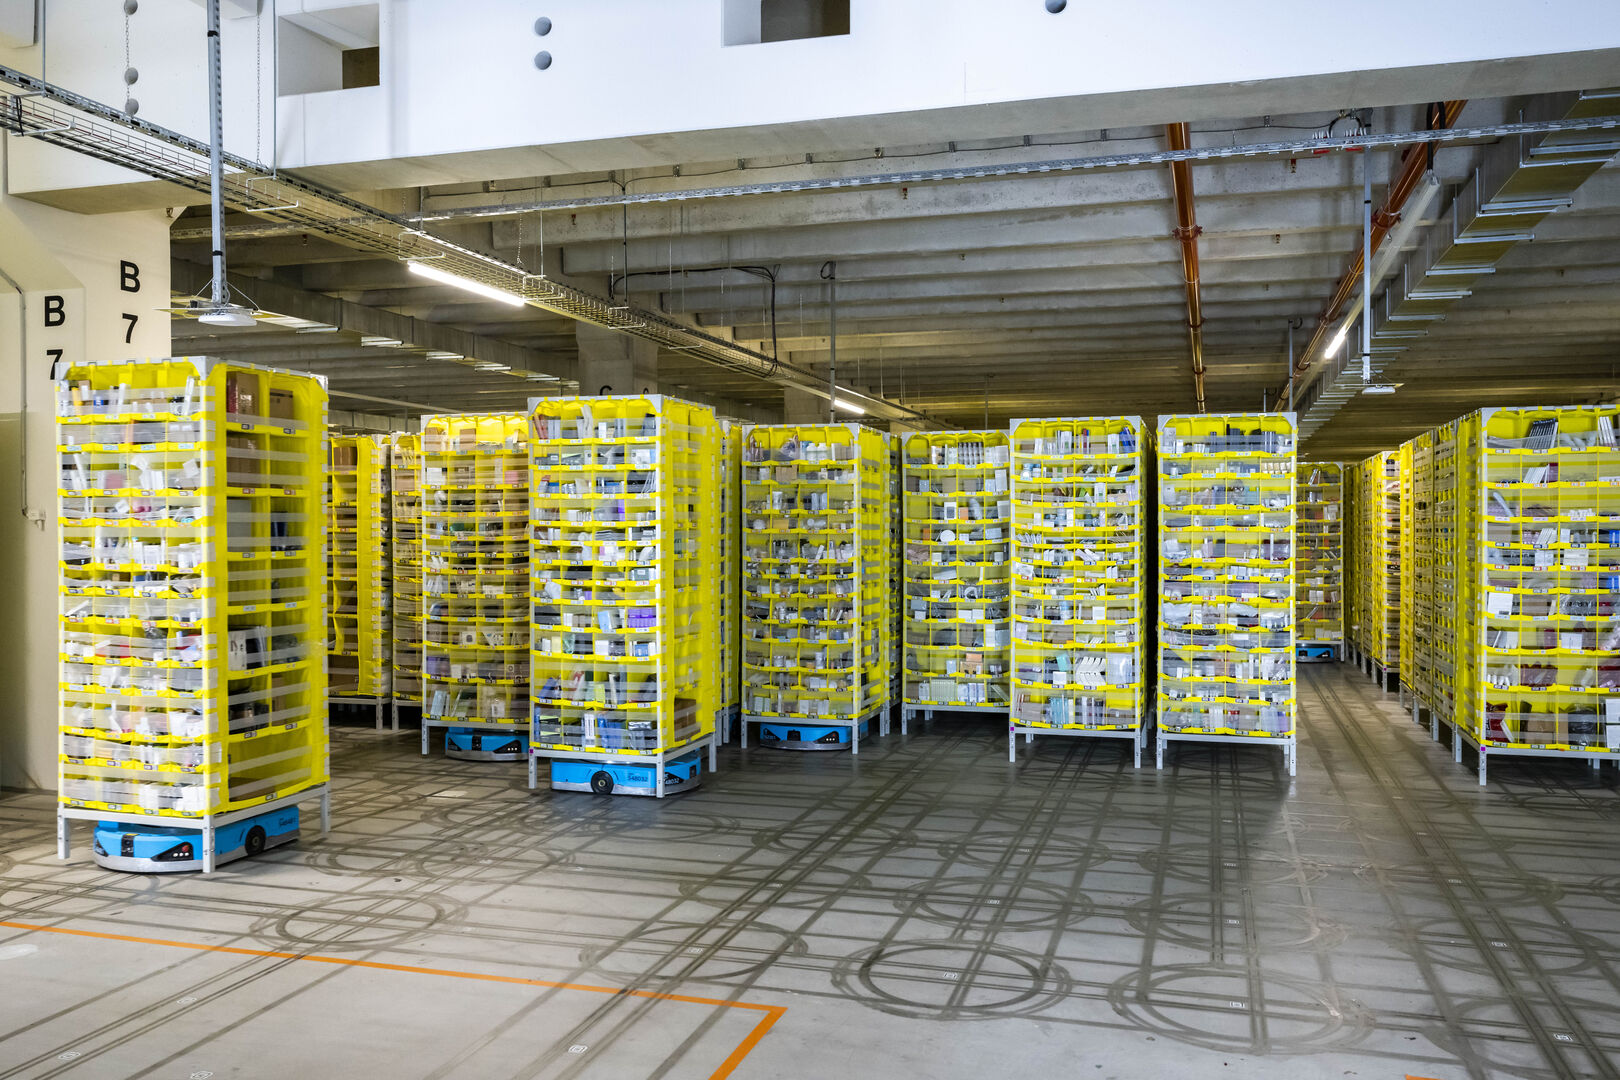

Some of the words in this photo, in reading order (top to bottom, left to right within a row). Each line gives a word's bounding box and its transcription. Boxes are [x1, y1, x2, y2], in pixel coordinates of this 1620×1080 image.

[120, 259, 141, 293] B
[44, 295, 66, 327] B
[122, 313, 139, 344] 7
[46, 349, 63, 380] 7
